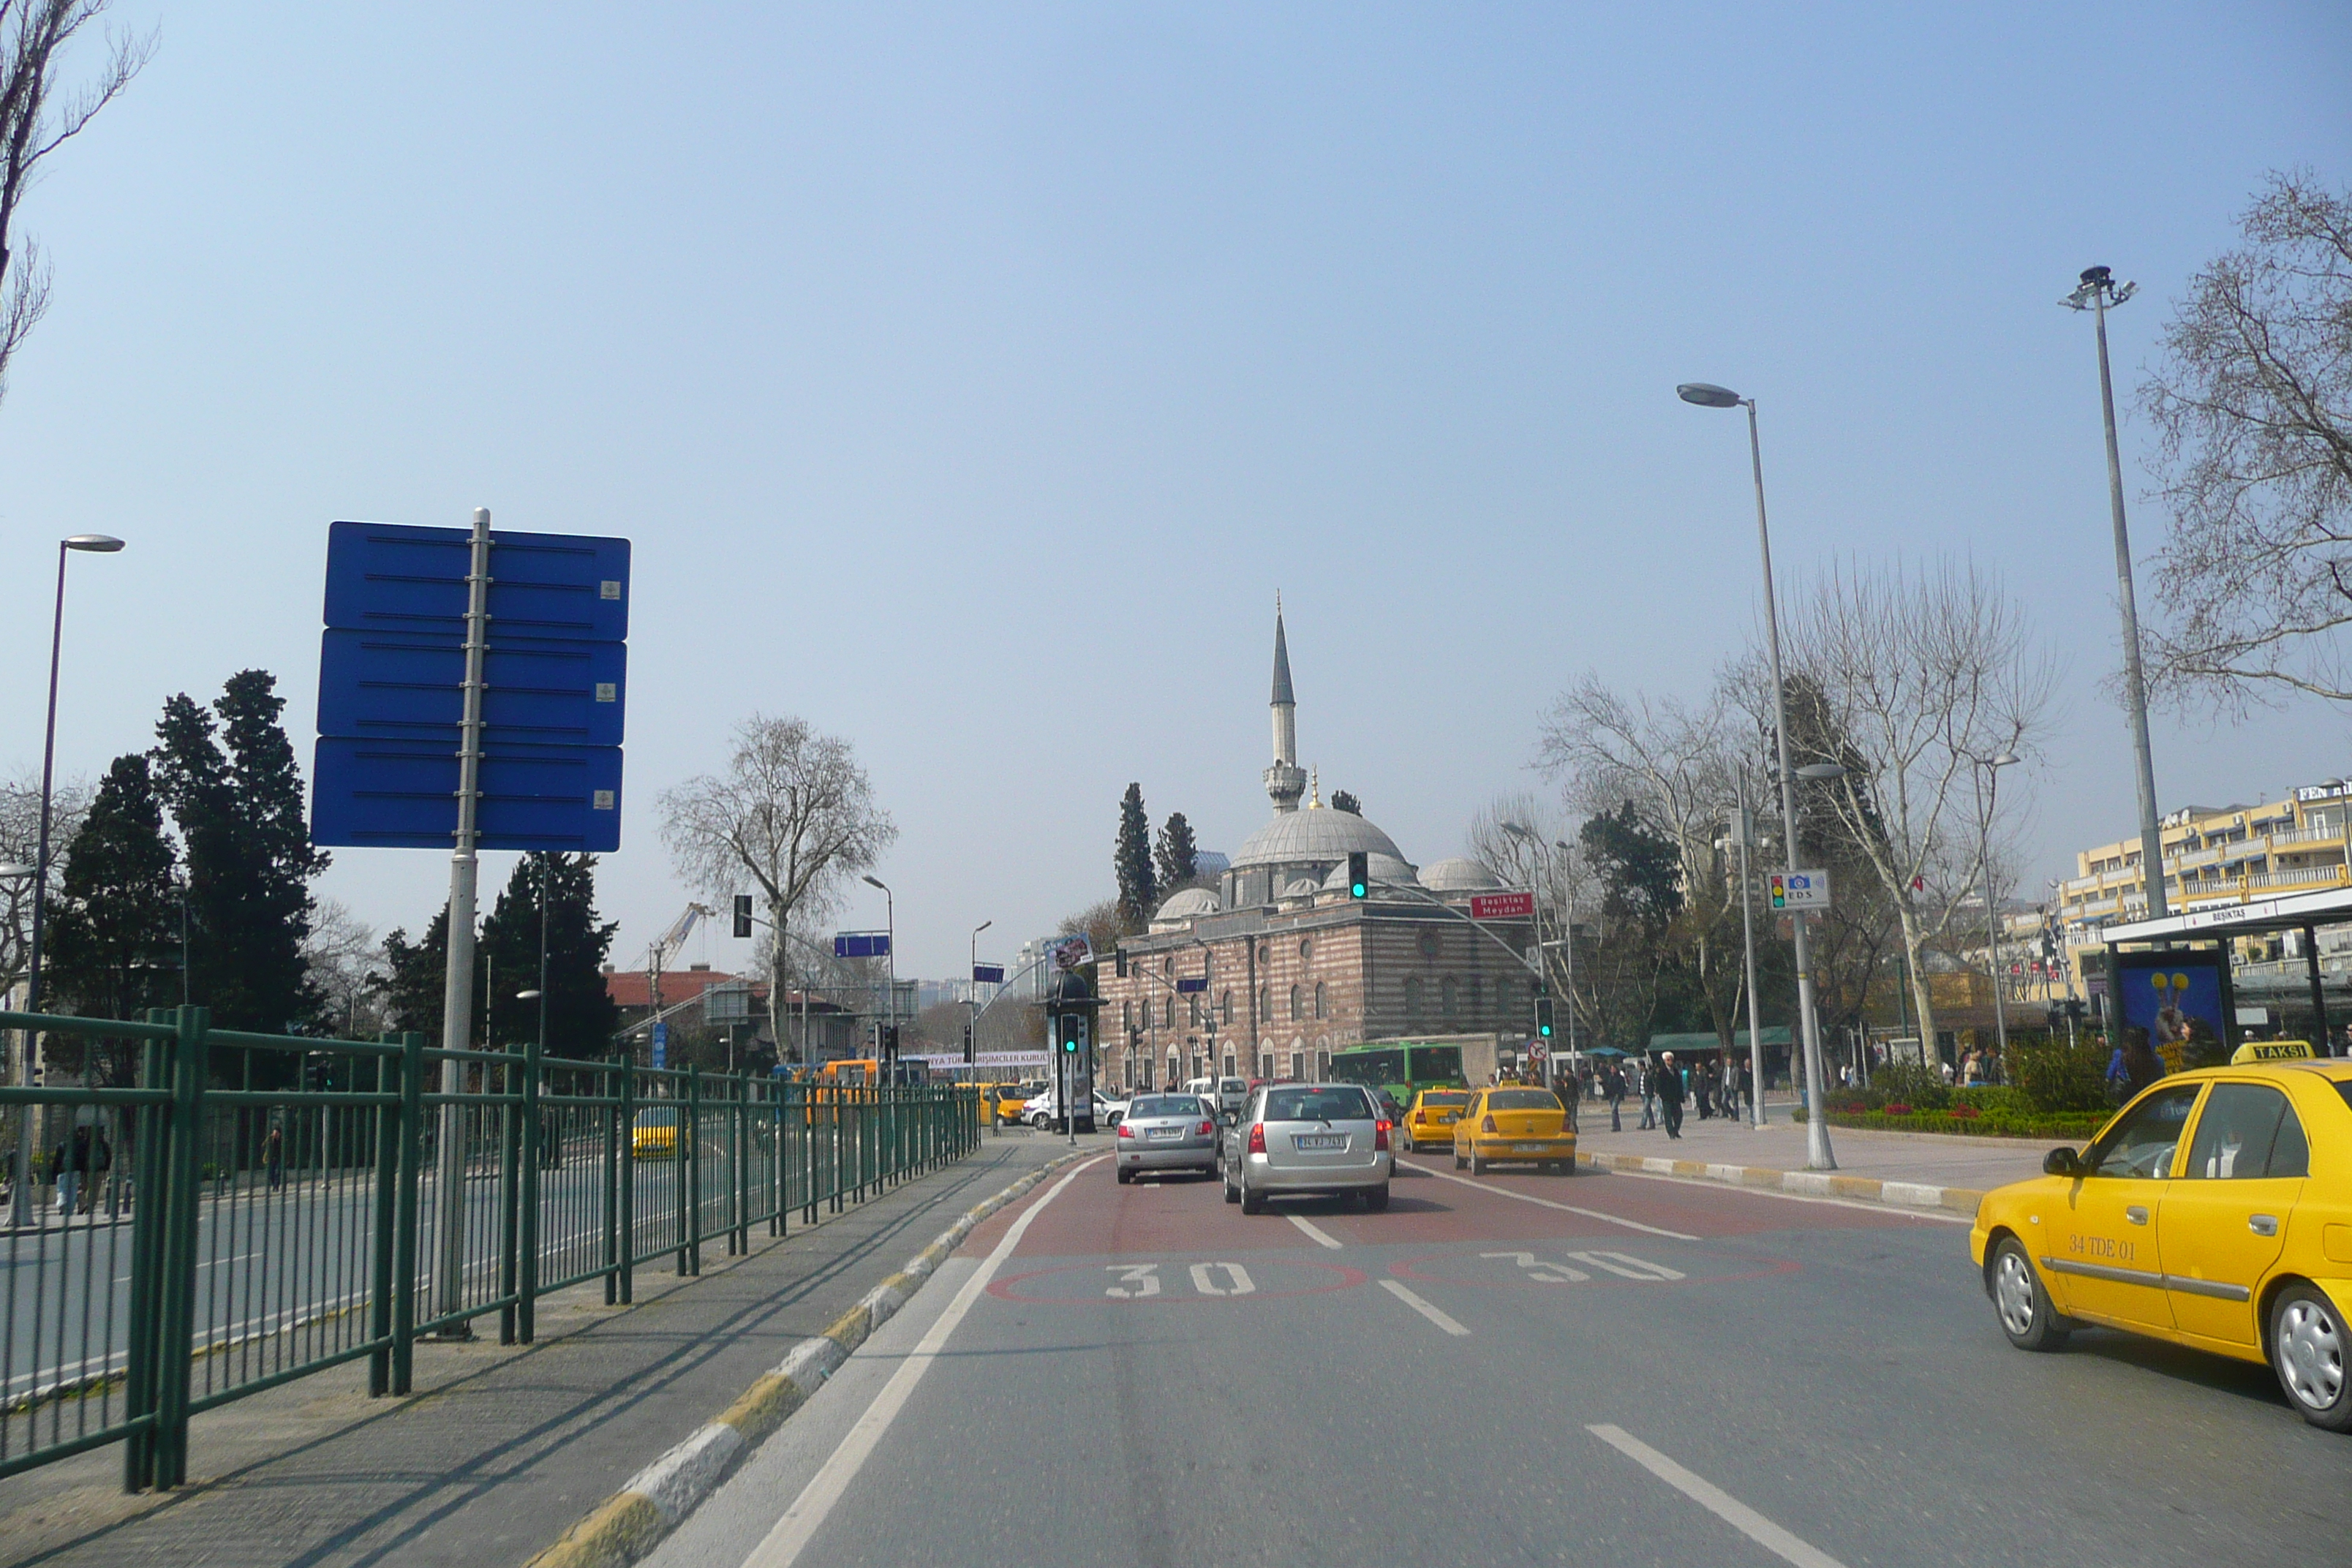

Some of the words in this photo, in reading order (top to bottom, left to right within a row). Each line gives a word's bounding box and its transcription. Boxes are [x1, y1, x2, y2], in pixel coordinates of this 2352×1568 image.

[2299, 787, 2327, 801] FEN
[1480, 896, 1524, 906] Beşiktaş
[1788, 891, 1812, 900] EDS
[1482, 905, 1523, 915] Meydan
[2212, 908, 2246, 922] BEŞİKTAŞ
[948, 1055, 965, 1064] TÜR
[975, 1053, 1019, 1064] İRİŞİMCİLER
[1021, 1052, 1047, 1062] KURUL
[1303, 1137, 1311, 1146] 34
[2069, 1234, 2084, 1254] 34
[2089, 1236, 2115, 1257] TDE
[2119, 1240, 2134, 1261] 01
[1480, 1251, 1686, 1281] 30
[1105, 1262, 1256, 1298] 30
